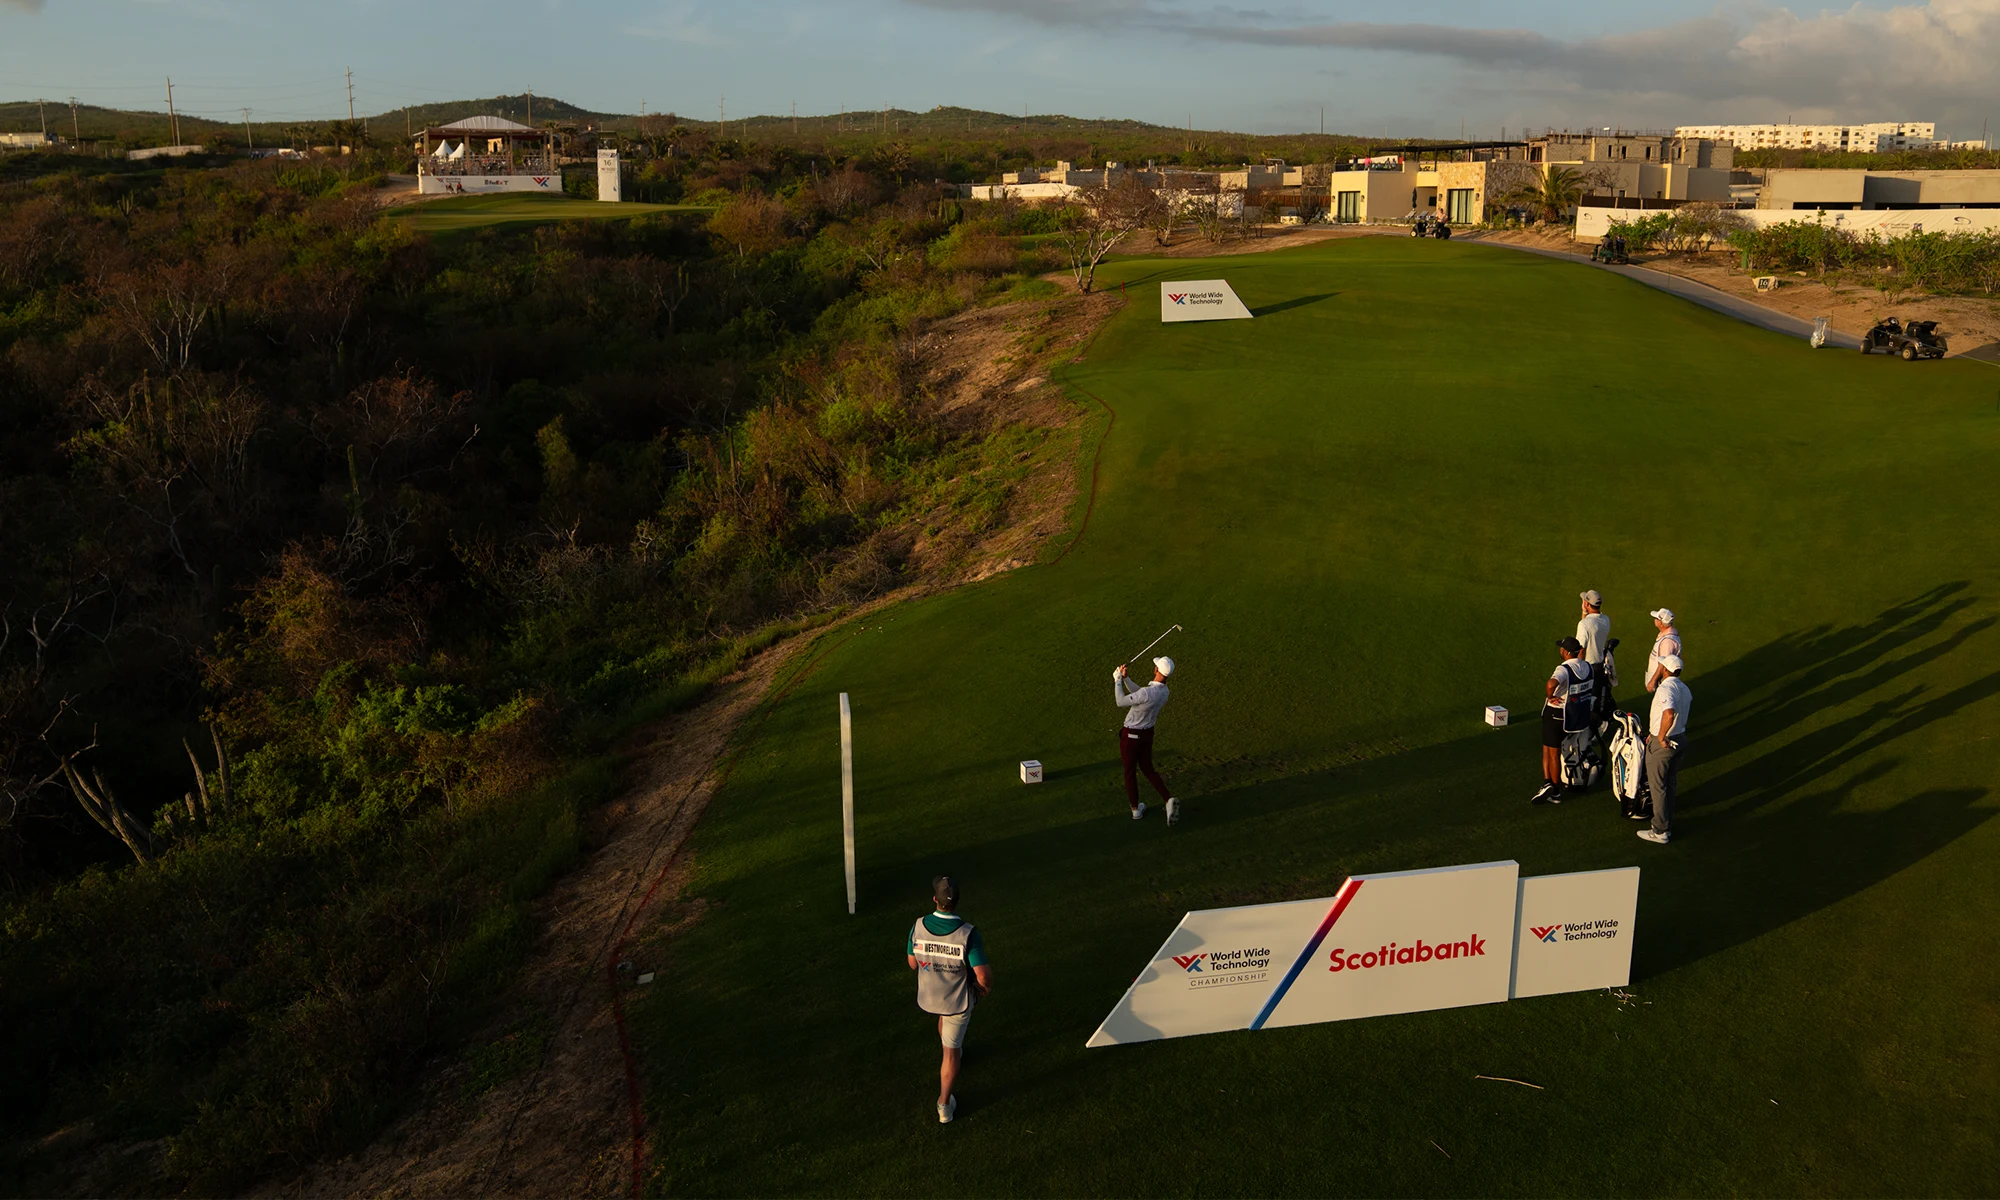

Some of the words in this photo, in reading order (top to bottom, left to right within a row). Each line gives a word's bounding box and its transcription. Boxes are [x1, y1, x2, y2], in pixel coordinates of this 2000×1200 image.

[1564, 921, 1592, 932] World
[1594, 919, 1618, 929] Wide
[1564, 930, 1618, 941] Technology
[924, 944, 960, 956] WESTMORELAND
[1210, 950, 1241, 961] World
[1244, 948, 1270, 957] Wide
[1329, 933, 1486, 972] Scotiabank
[1210, 958, 1270, 970] Technology
[1190, 972, 1267, 986] CHAMPIONSHIP
